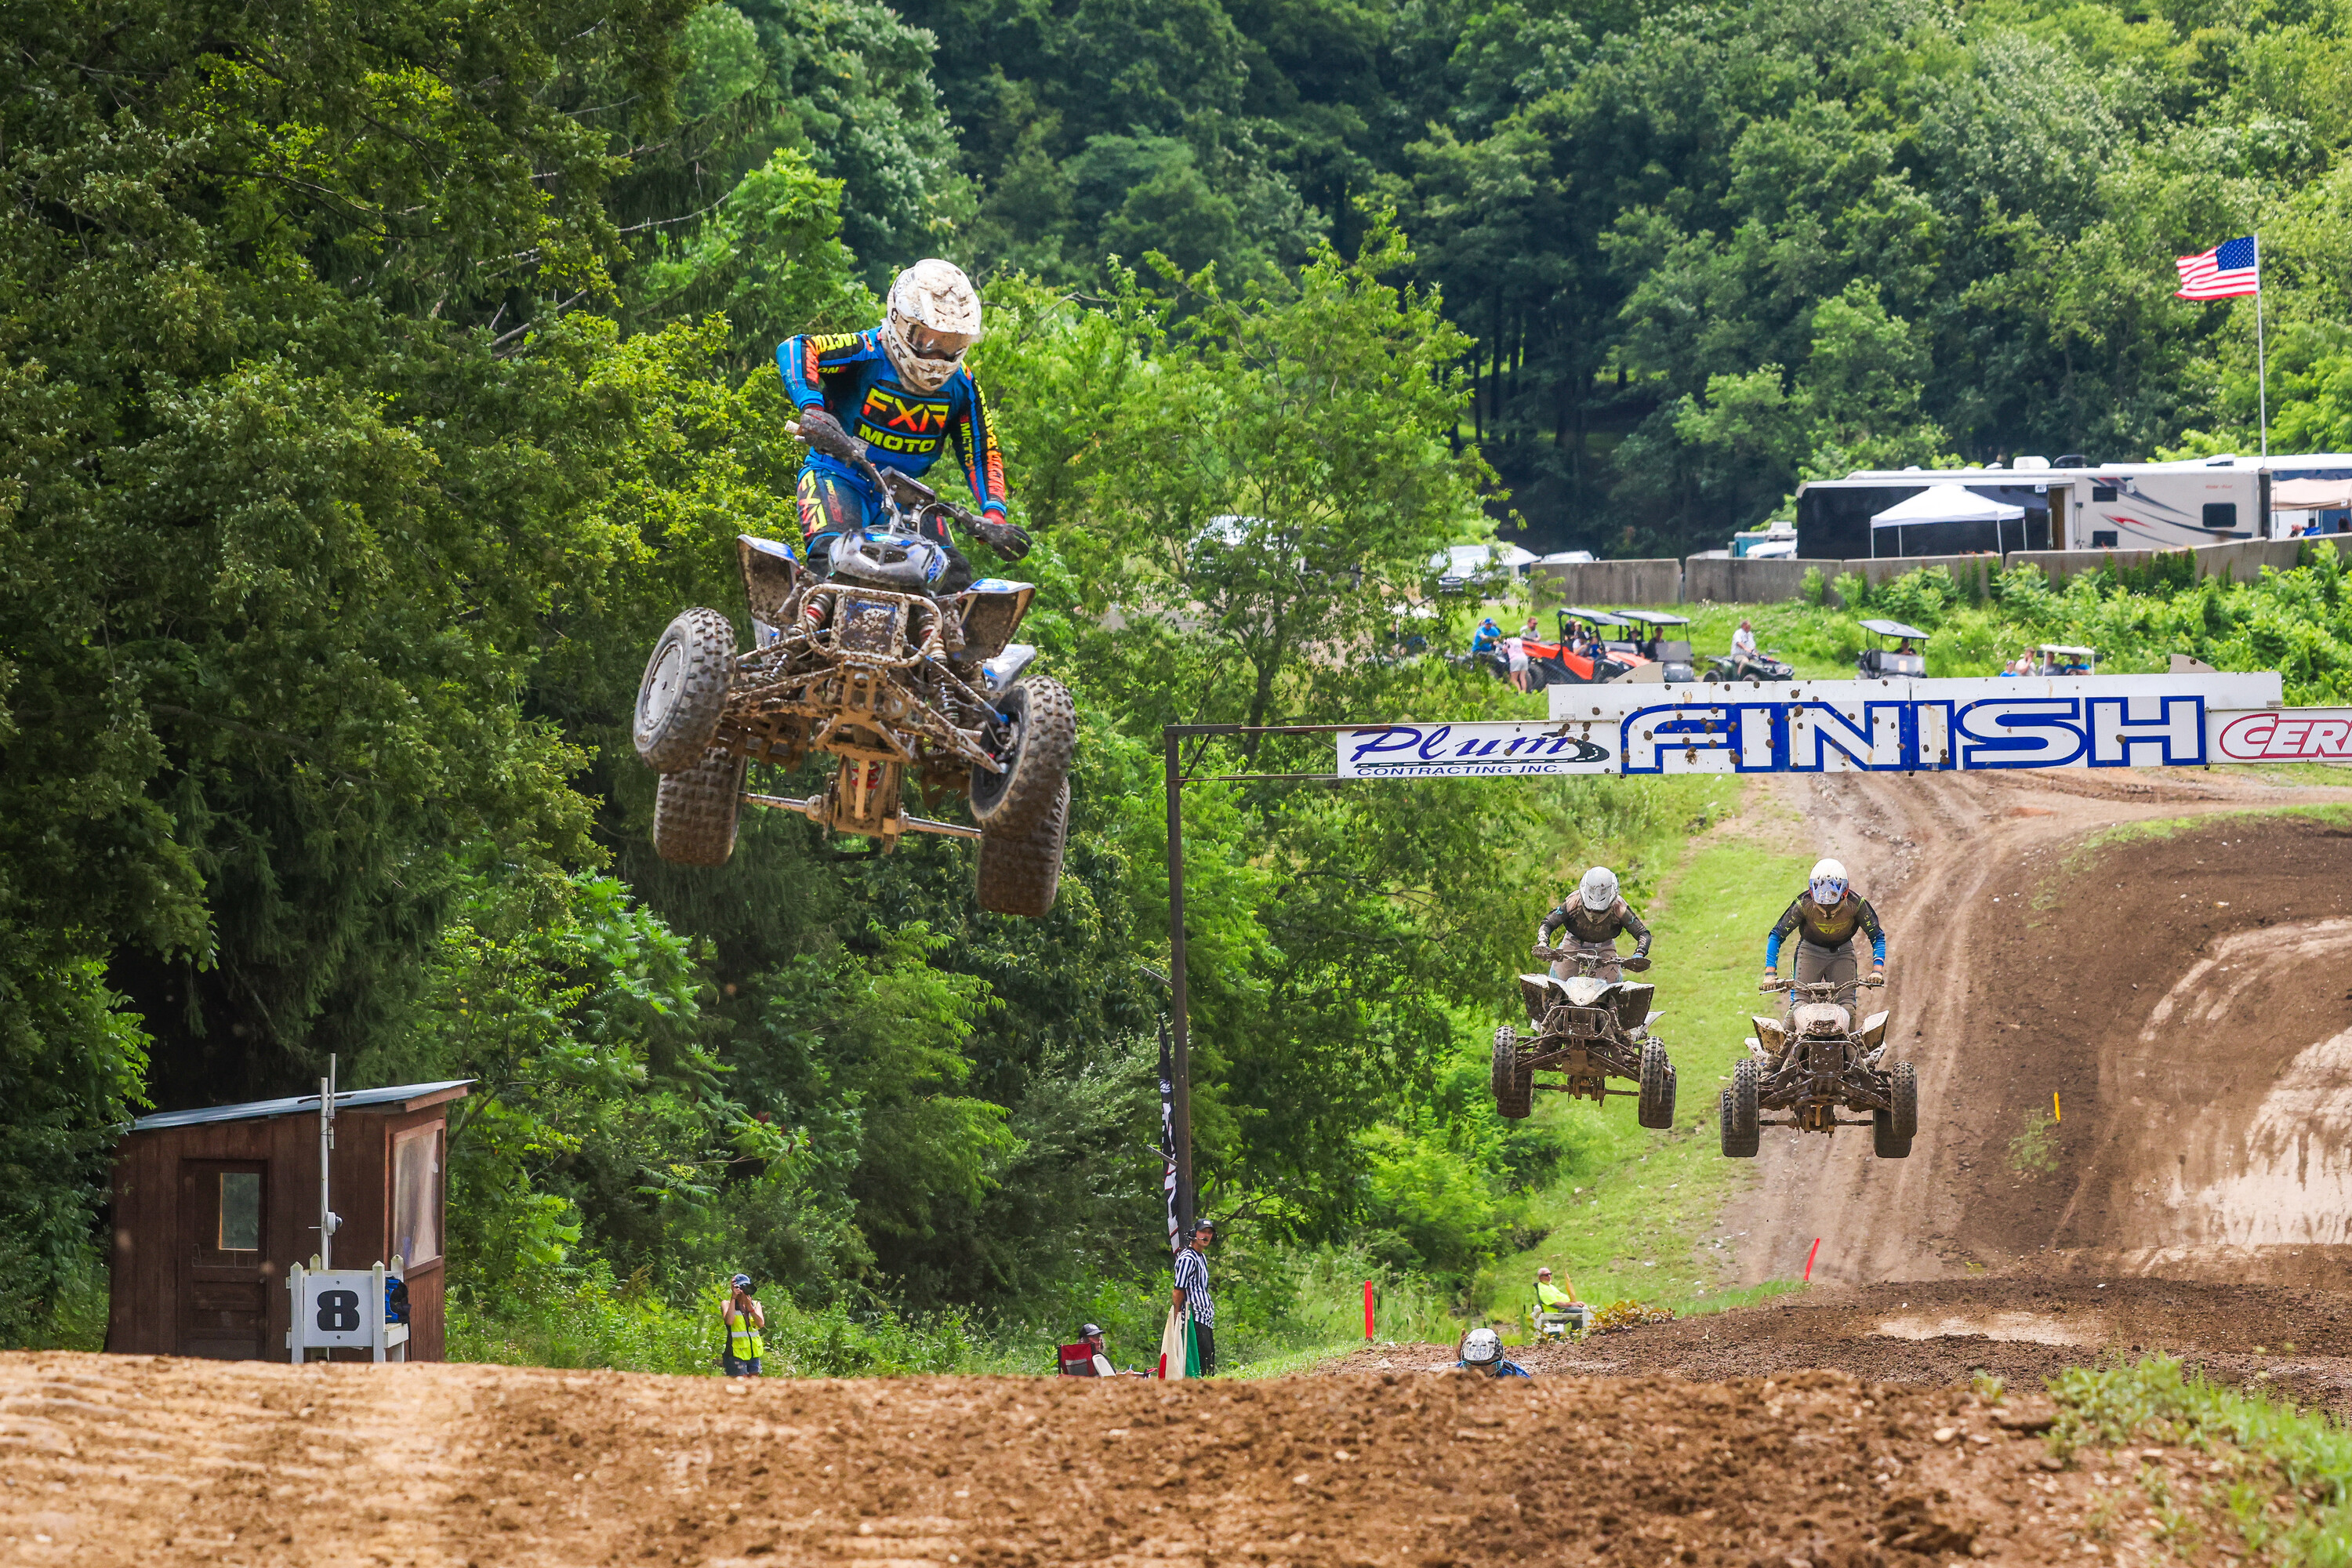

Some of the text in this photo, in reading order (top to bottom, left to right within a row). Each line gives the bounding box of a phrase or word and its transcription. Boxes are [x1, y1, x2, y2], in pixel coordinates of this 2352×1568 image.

[863, 387, 949, 432] FXR
[858, 423, 936, 452] MOTO
[1349, 725, 1571, 762] Plum
[1620, 695, 2207, 774] FINISH
[2219, 713, 2352, 760] CER
[1356, 764, 1564, 776] CONTRACTING INC.
[317, 1290, 360, 1331] 8
